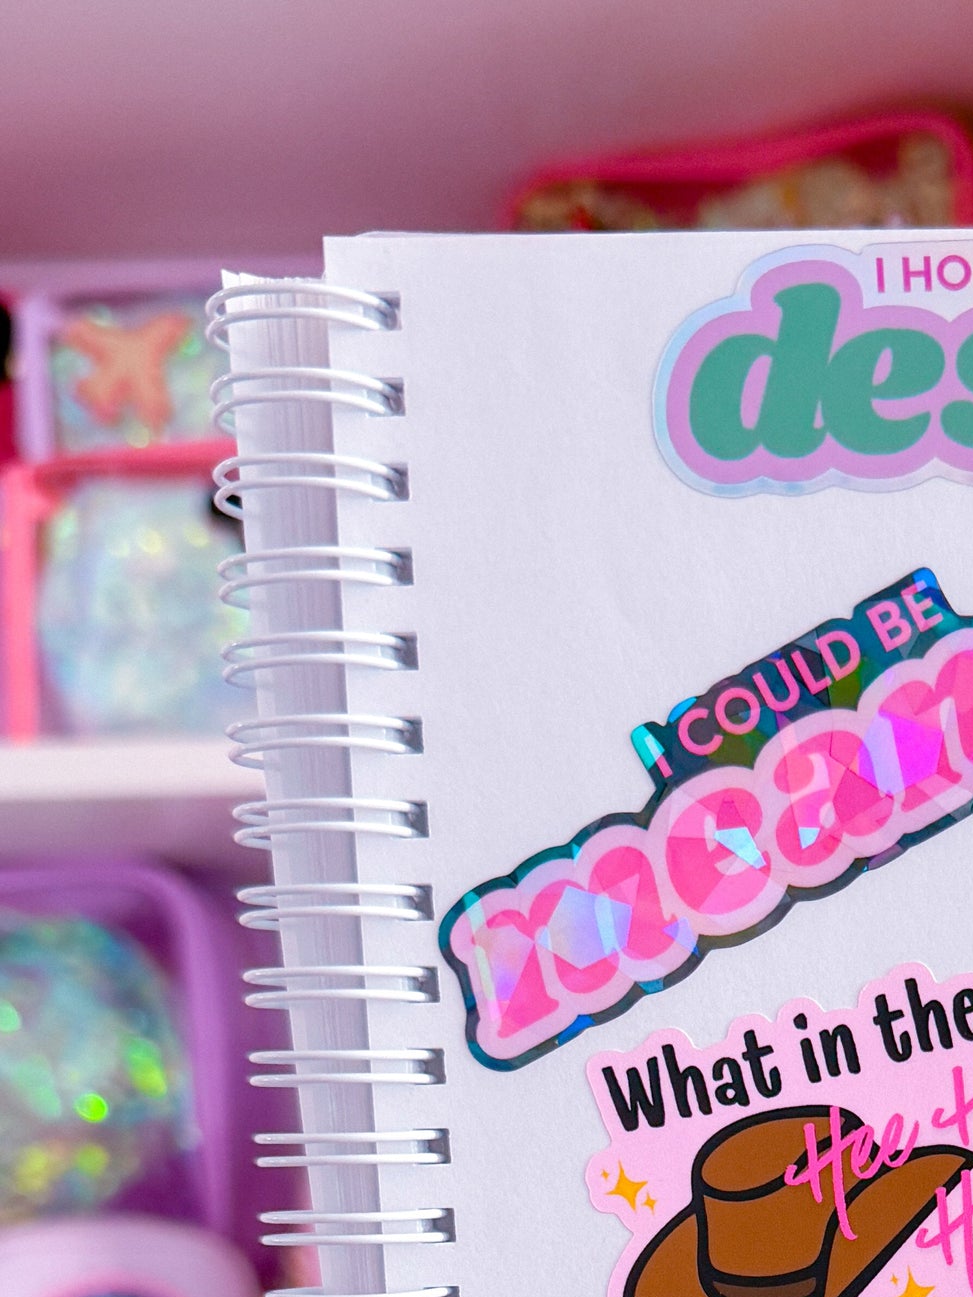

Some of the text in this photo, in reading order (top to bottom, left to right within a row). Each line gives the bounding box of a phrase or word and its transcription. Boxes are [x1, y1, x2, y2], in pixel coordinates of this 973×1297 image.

[876, 257, 886, 293] I
[643, 580, 946, 779] I COULD BE
[602, 1029, 783, 1131] What
[799, 1012, 861, 1083] in
[785, 1105, 921, 1240] Hee
